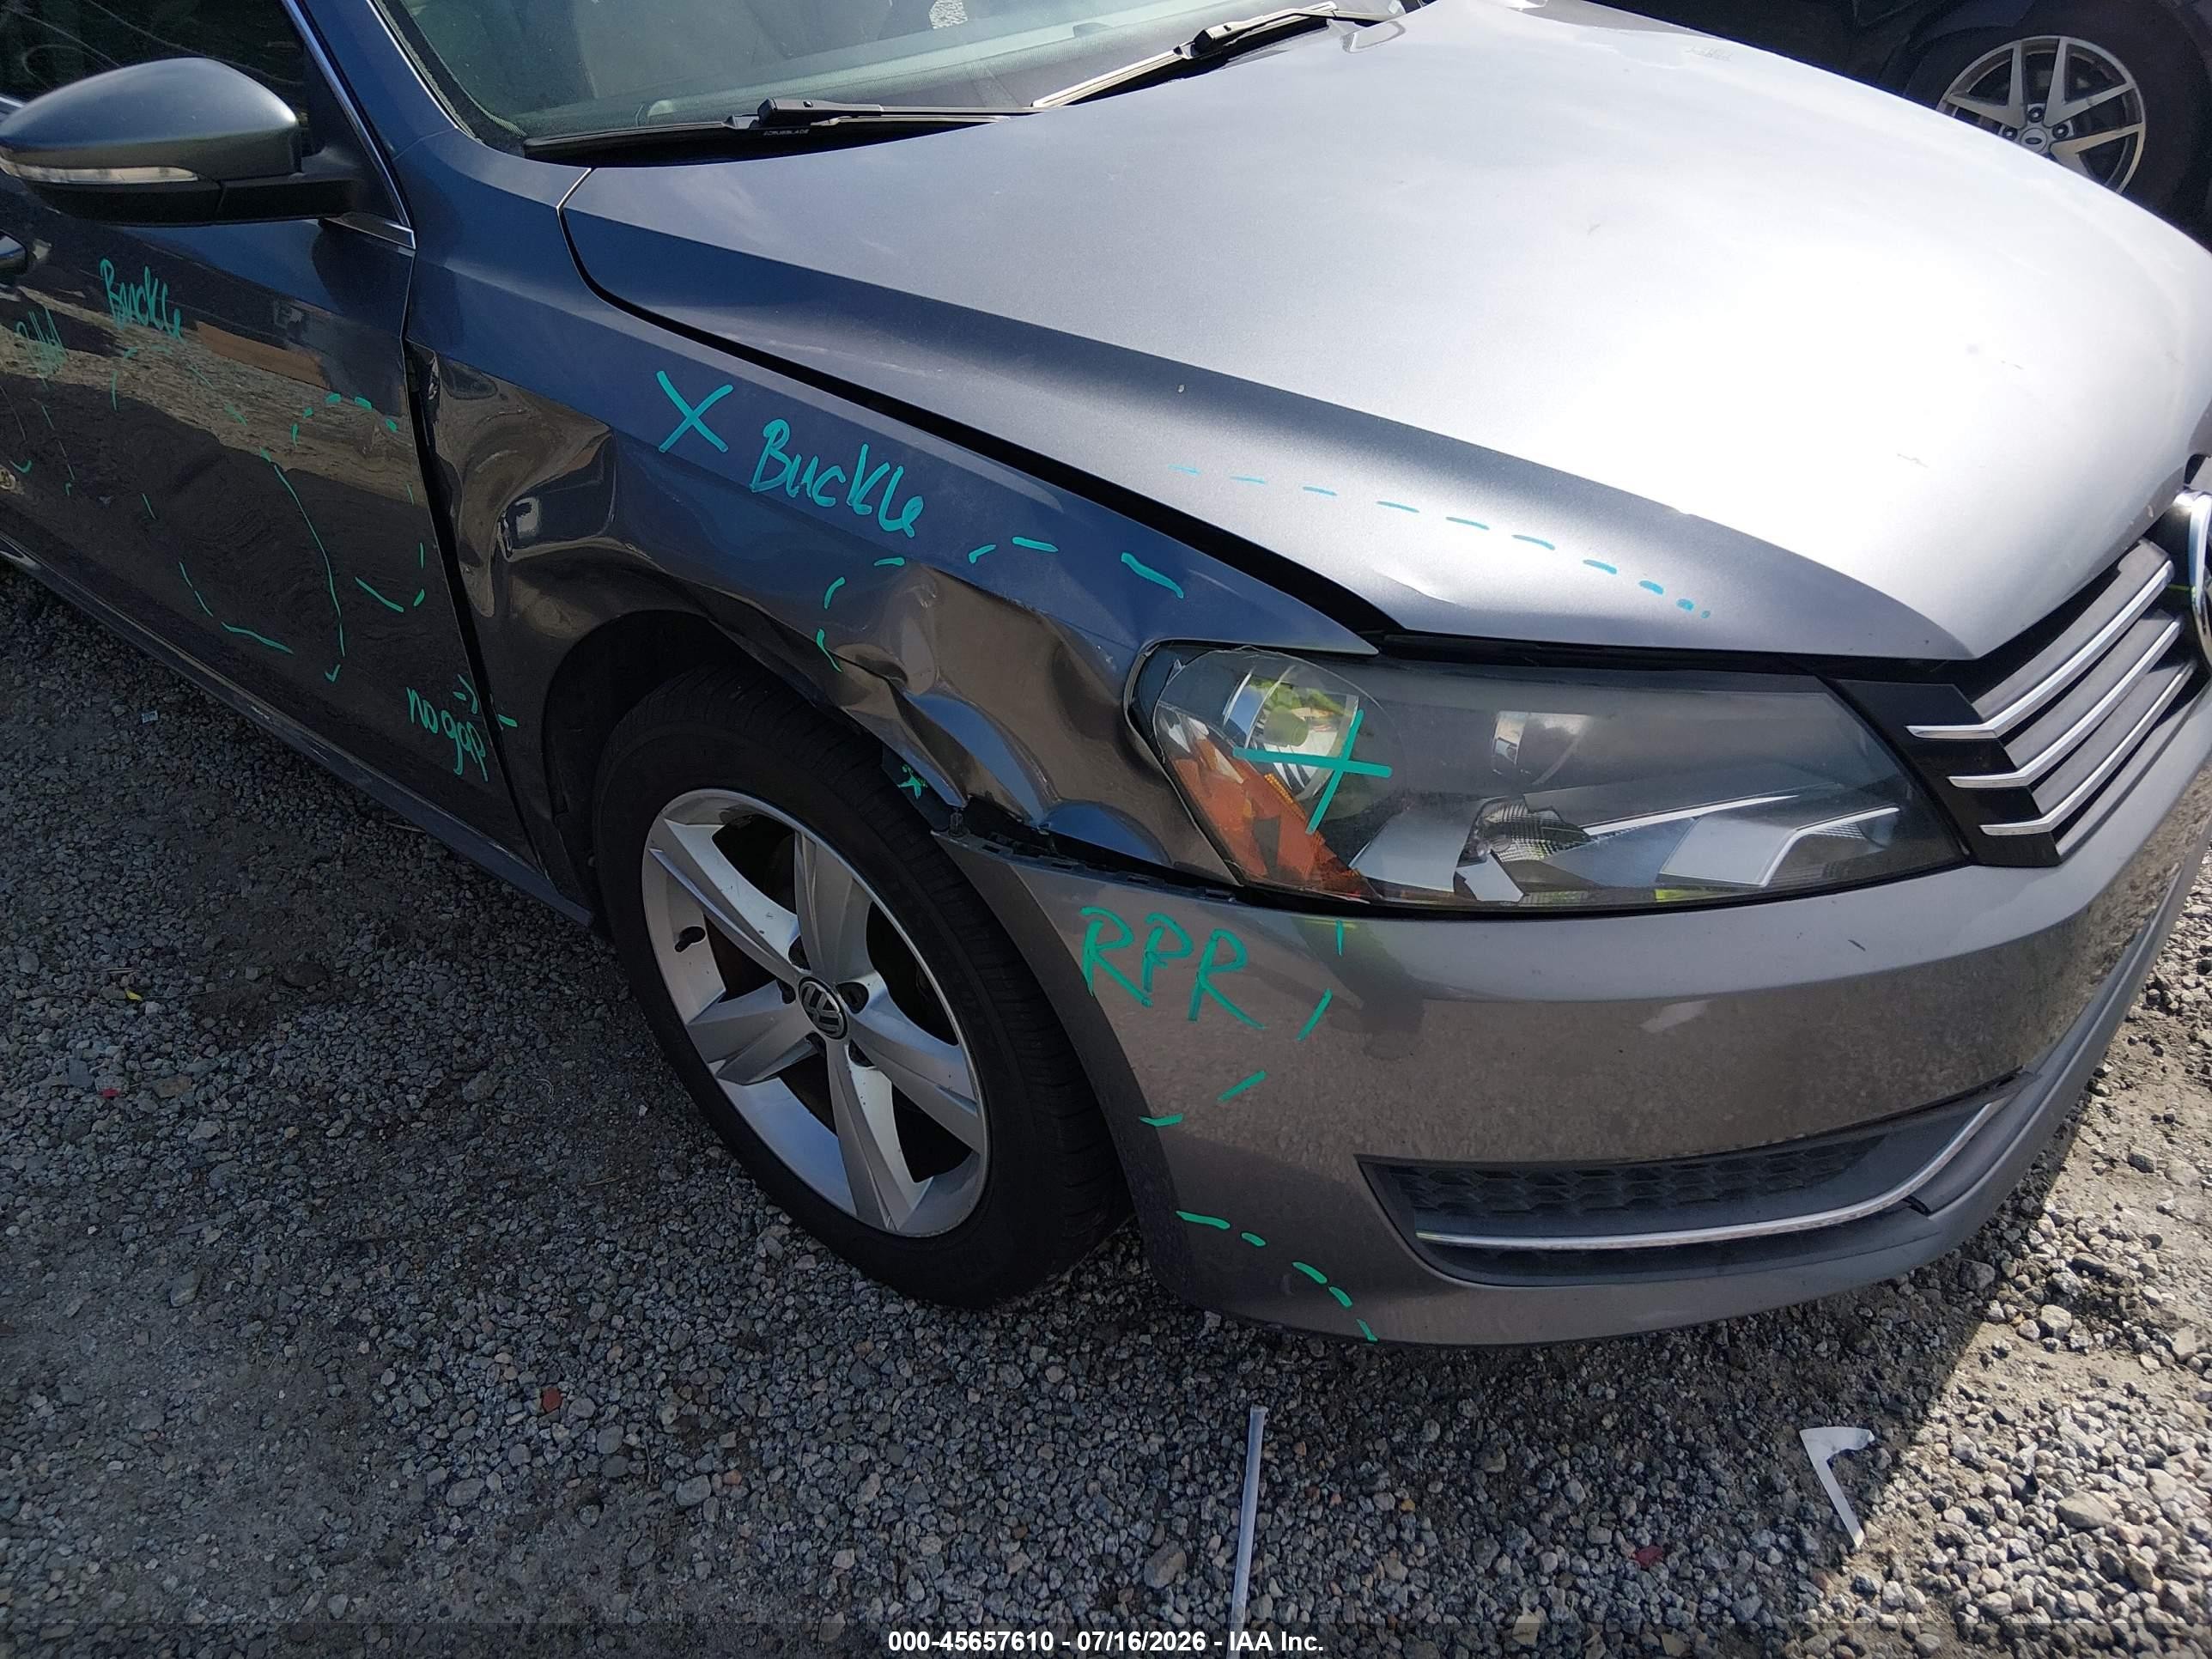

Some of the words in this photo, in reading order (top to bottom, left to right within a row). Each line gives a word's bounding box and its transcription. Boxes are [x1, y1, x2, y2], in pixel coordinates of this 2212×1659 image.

[749, 417, 926, 538] Buckle
[406, 686, 439, 734] no
[441, 709, 489, 782] gap
[1079, 906, 1266, 1029] RPR
